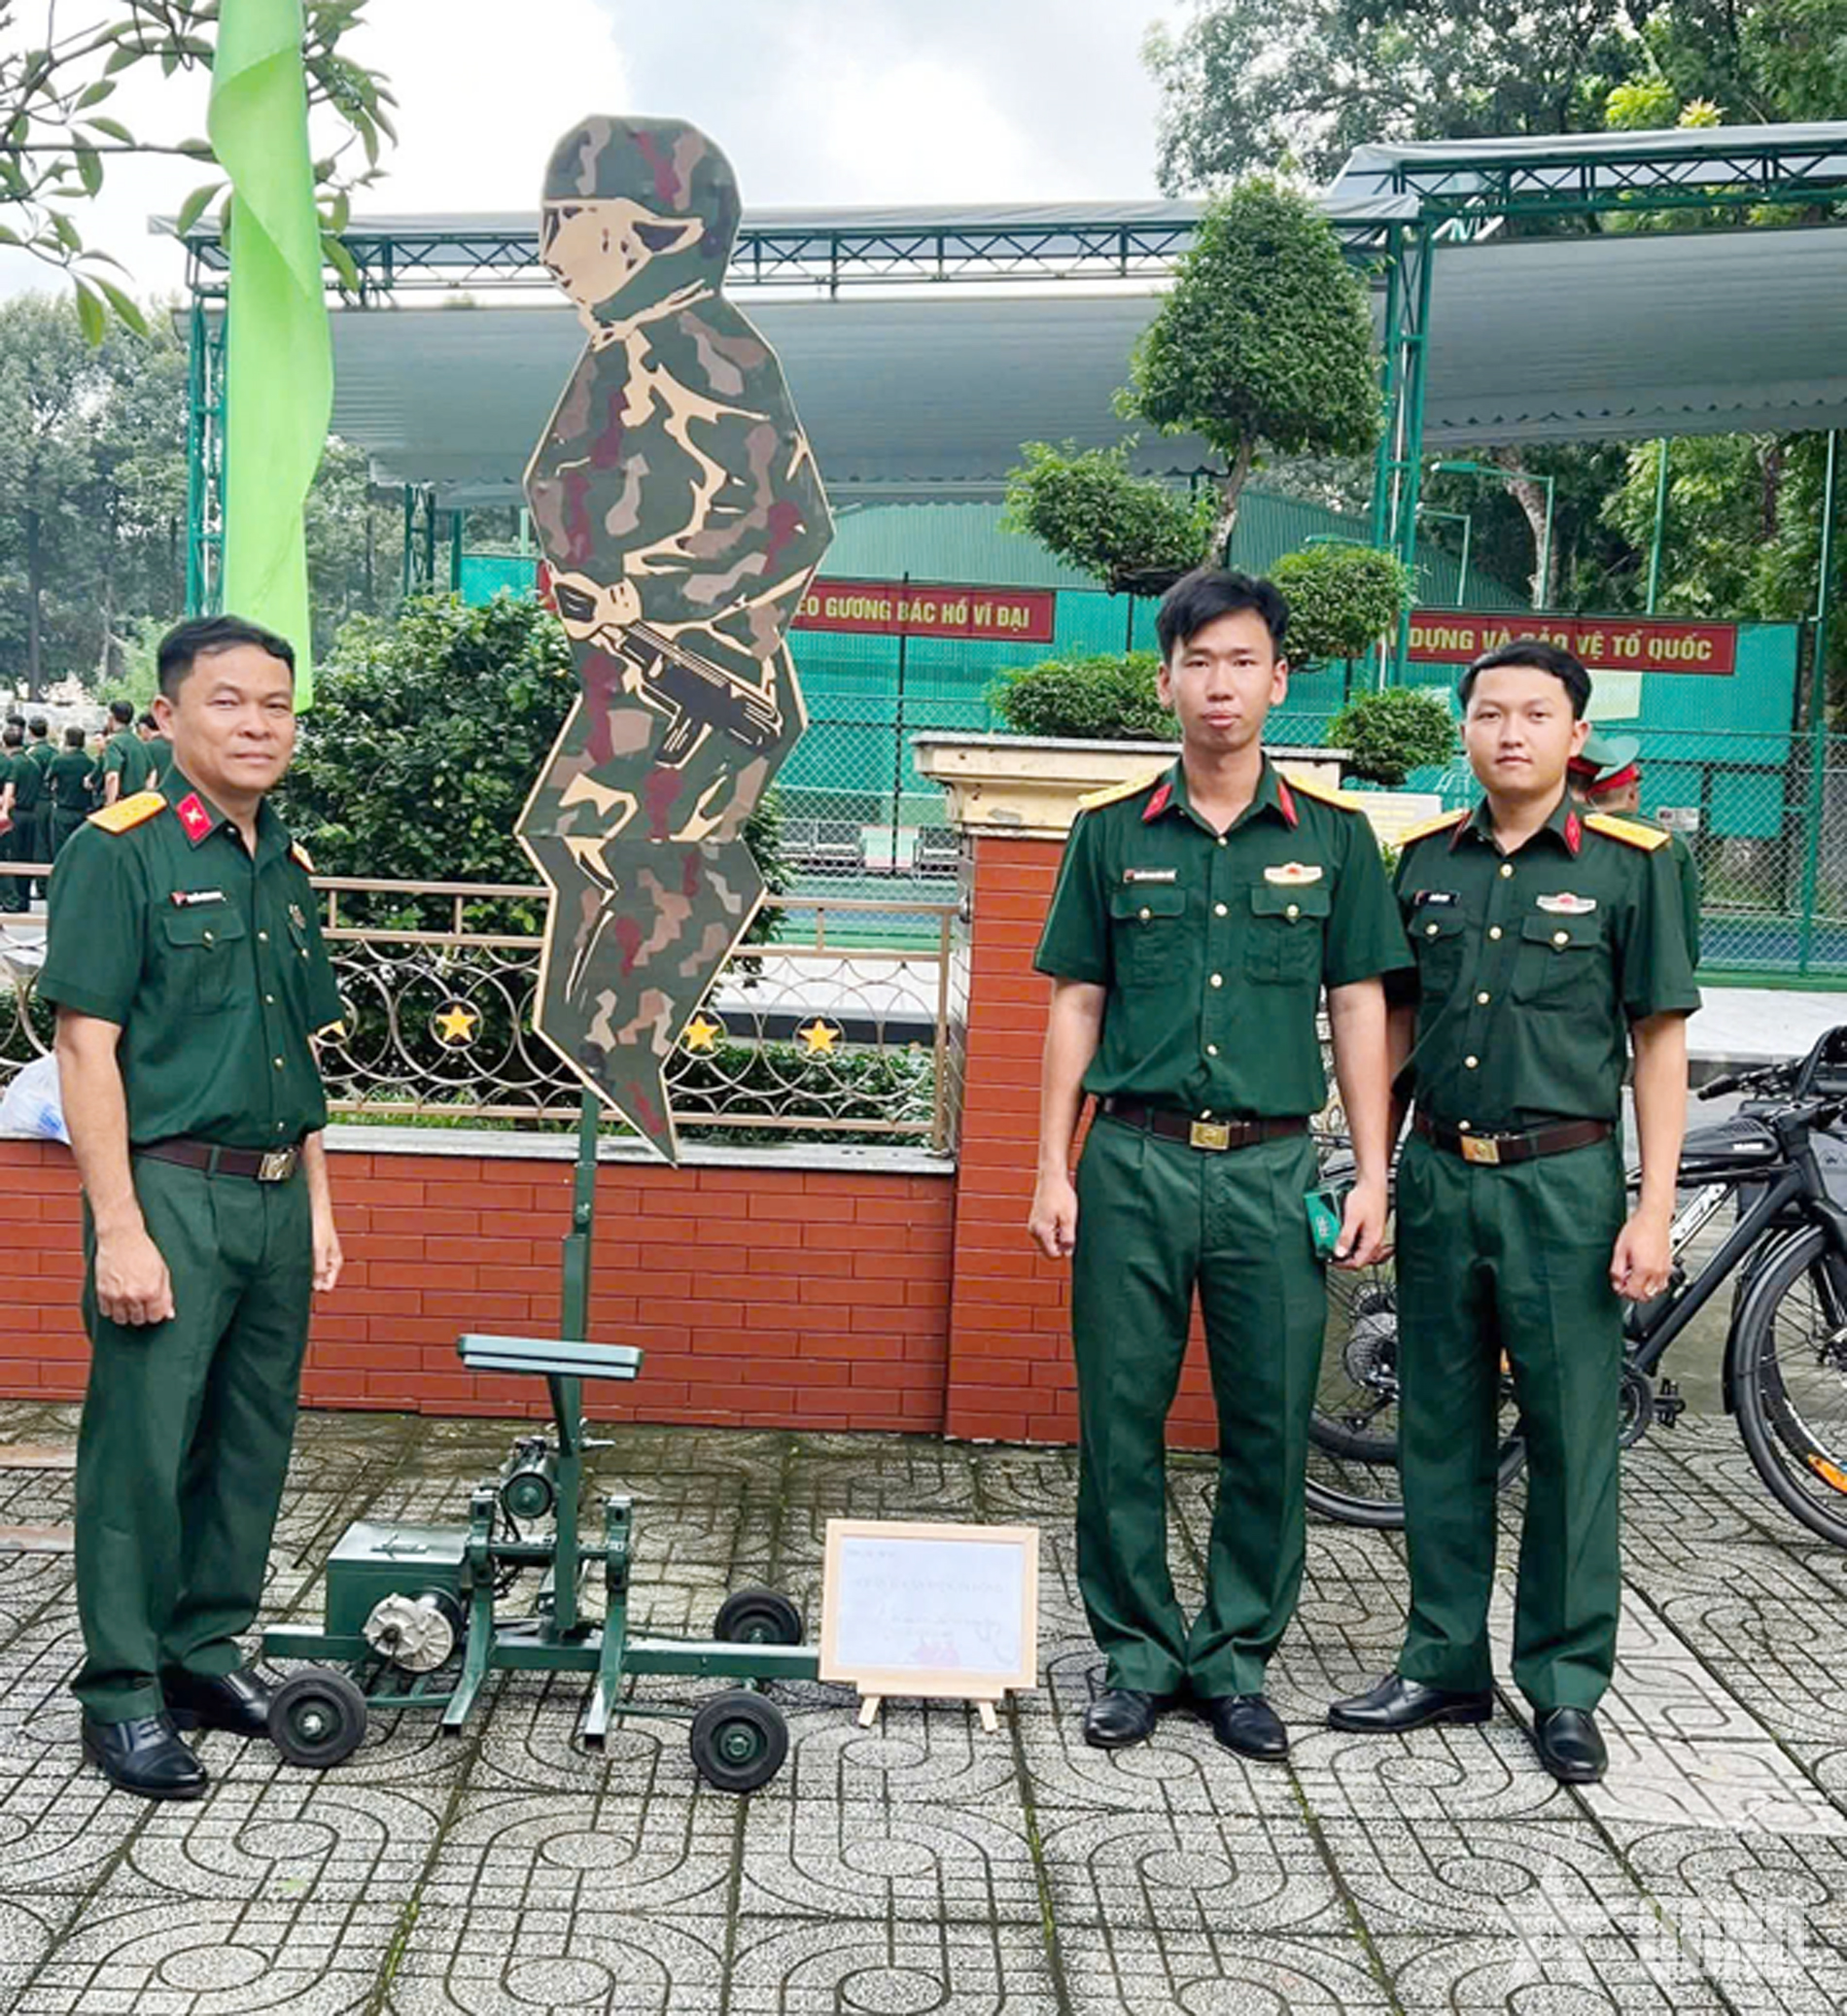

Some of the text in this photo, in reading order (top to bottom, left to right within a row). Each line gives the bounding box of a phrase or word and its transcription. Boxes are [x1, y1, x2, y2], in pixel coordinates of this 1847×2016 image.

[825, 596, 891, 621] GƯƠNG
[897, 597, 936, 624] BÁC
[973, 602, 993, 627] VĨ
[996, 605, 1029, 633] ĐẠI
[1409, 626, 1475, 654] DỰNG
[1577, 630, 1604, 660] VỆ
[1612, 629, 1643, 658] TỔ
[1648, 632, 1712, 661] QUỐC
